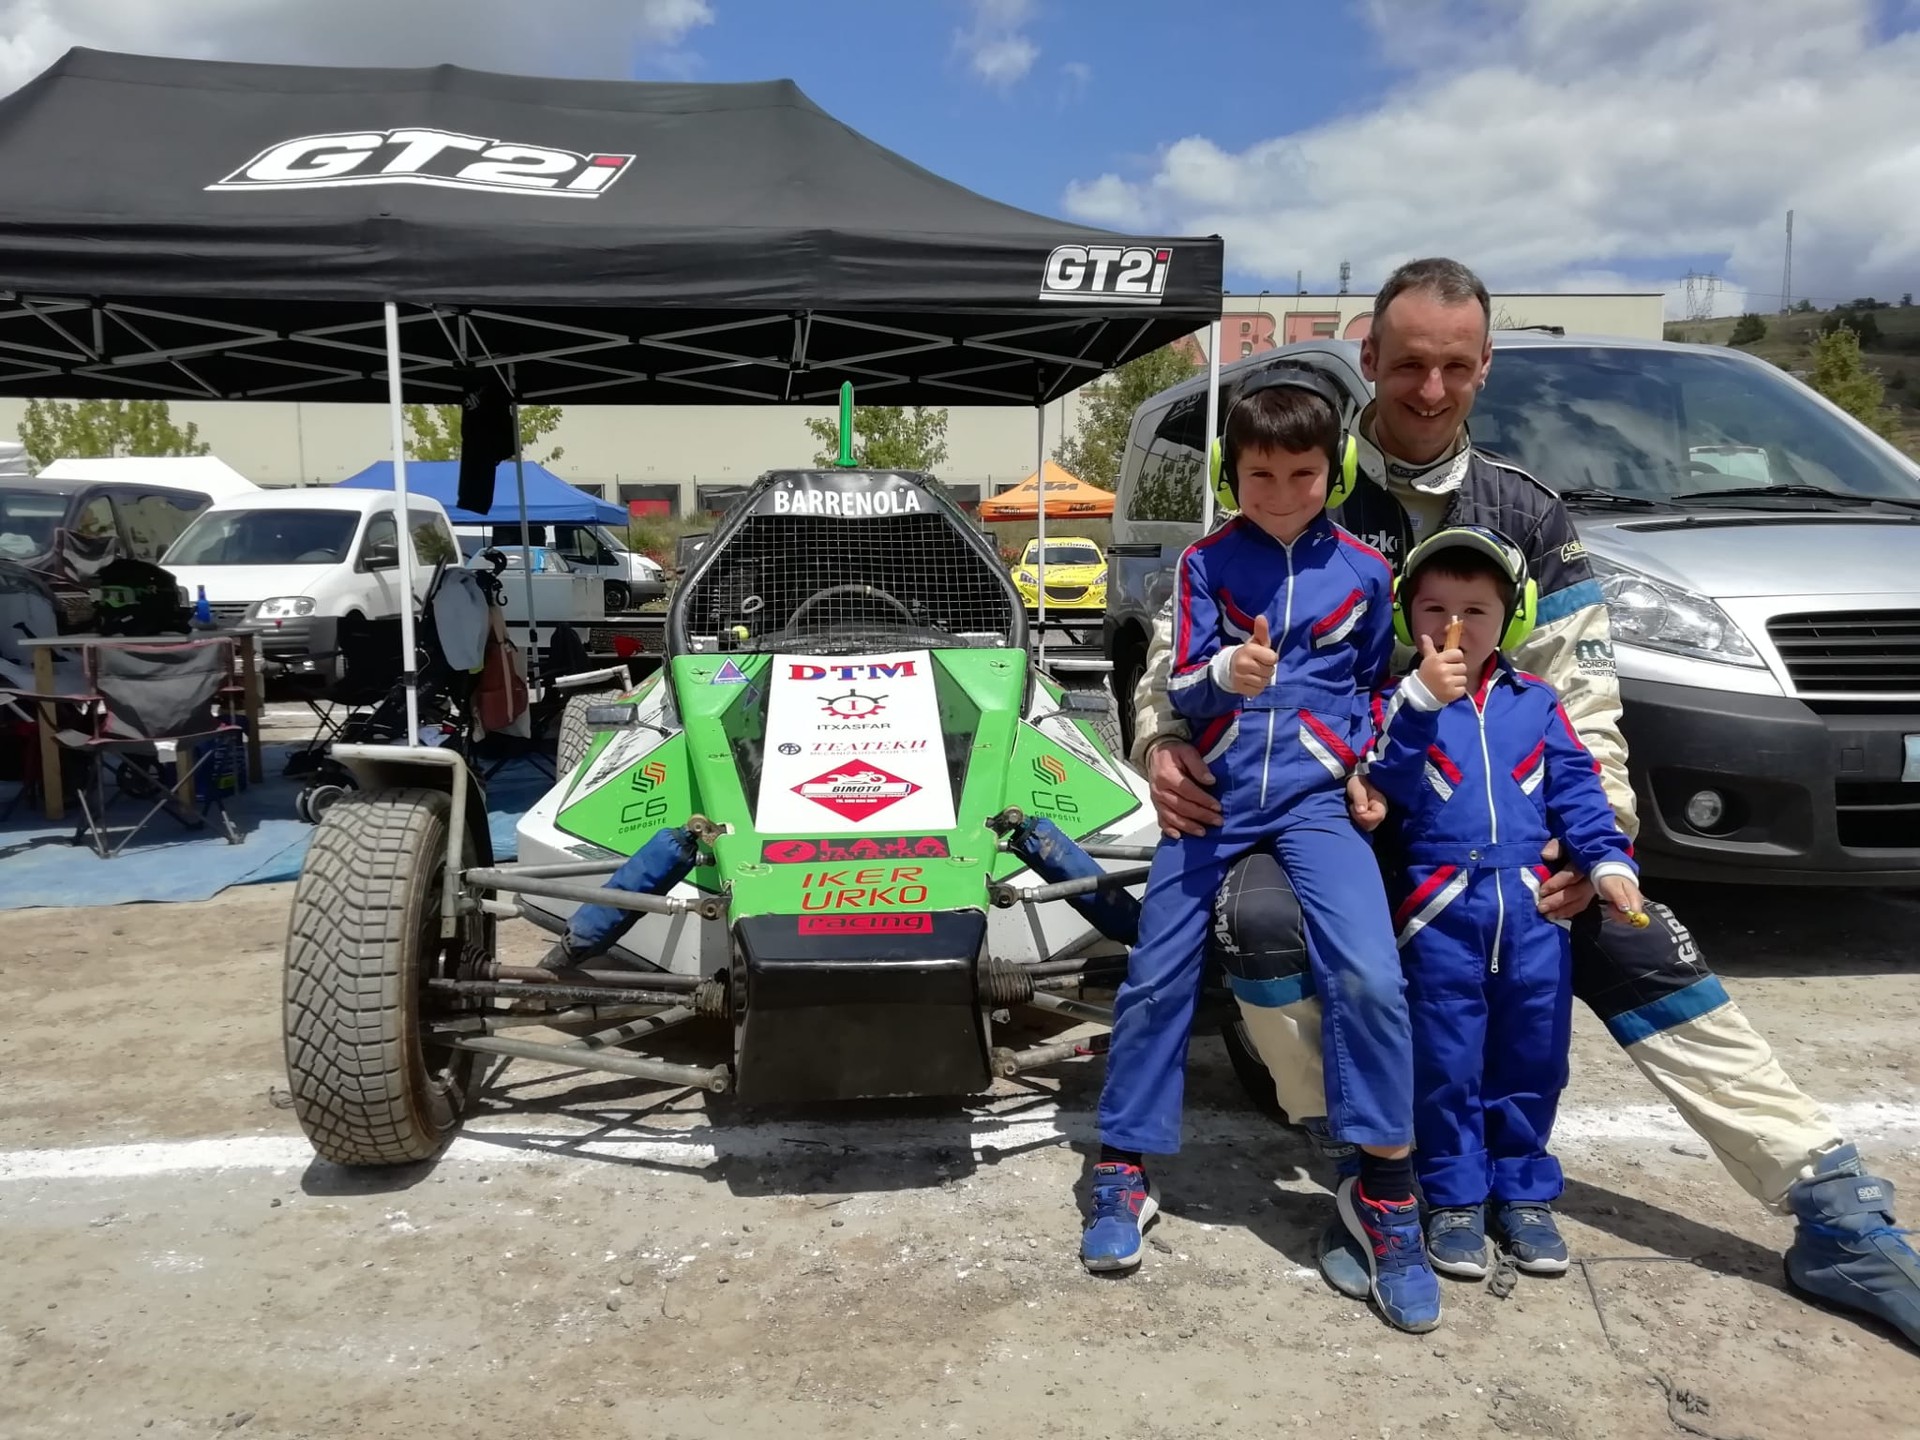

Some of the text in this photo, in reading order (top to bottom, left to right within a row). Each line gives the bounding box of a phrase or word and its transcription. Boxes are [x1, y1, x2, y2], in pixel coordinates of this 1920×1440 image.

[245, 129, 625, 191] GT2i
[1045, 247, 1169, 293] GT2i
[773, 489, 922, 517] BARRENOLA
[788, 660, 918, 681] DTM
[816, 722, 892, 732] ITXASFAR
[831, 785, 882, 793] BIMOTO
[621, 796, 668, 824] C6
[1031, 790, 1079, 813] C6
[618, 816, 668, 835] COMPOSITE
[1034, 809, 1083, 824] COMPOSITE
[802, 866, 924, 889] IKER
[802, 884, 929, 911] URKO
[807, 915, 925, 930] racing
